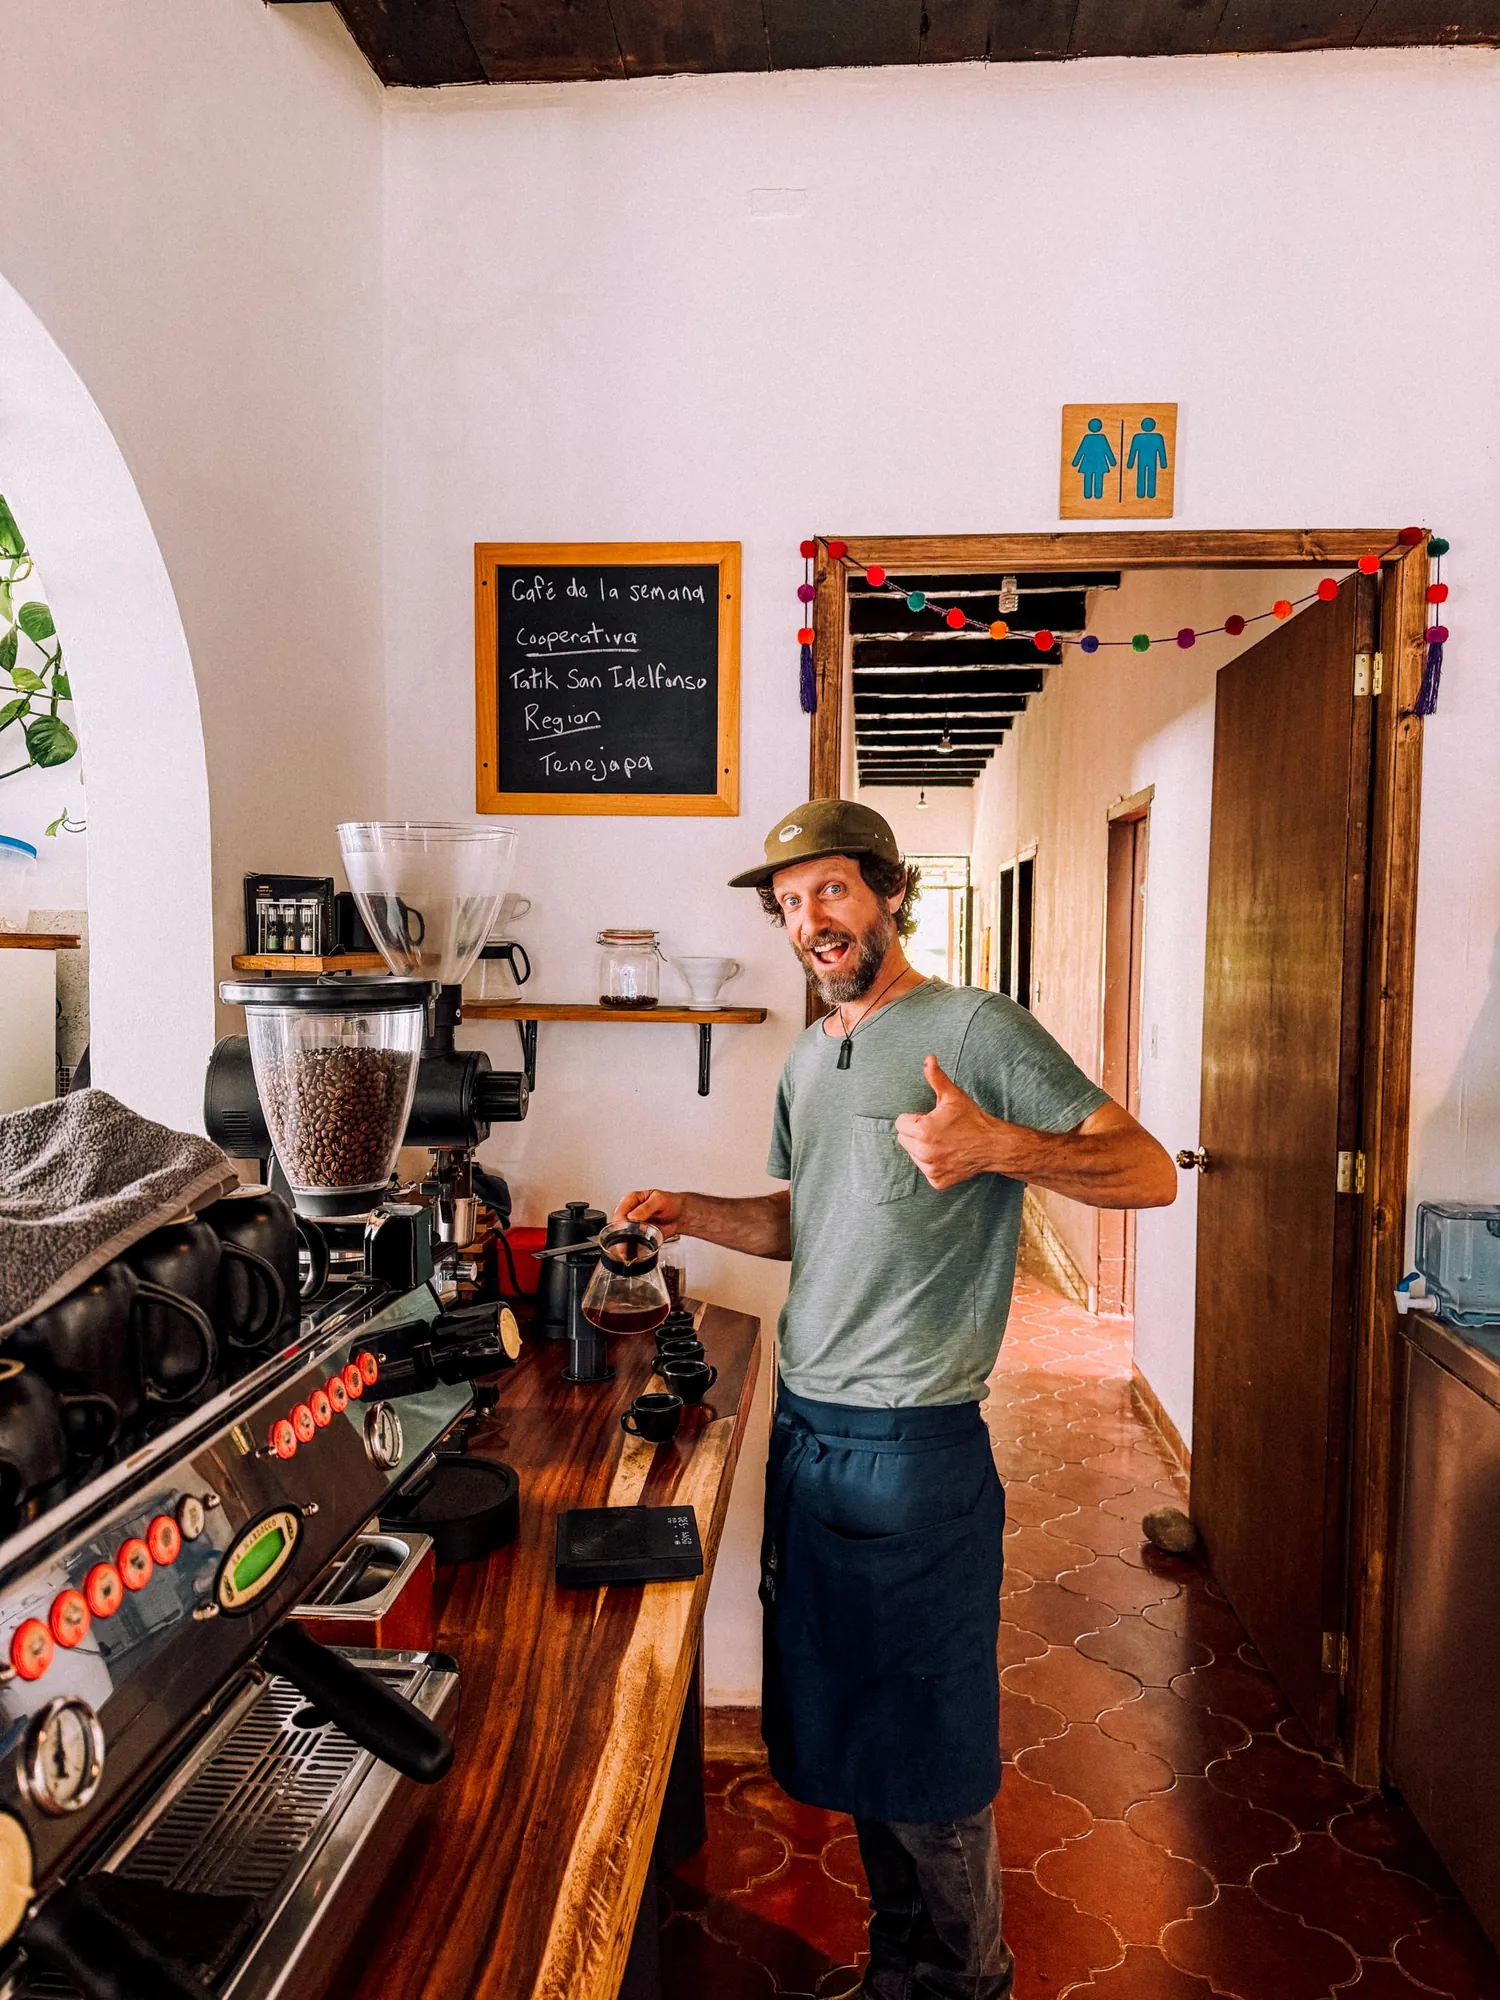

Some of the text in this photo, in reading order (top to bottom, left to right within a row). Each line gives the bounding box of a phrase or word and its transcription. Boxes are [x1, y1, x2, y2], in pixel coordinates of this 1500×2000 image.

[511, 575, 705, 603] Café de la semana
[516, 622, 638, 652] Cooperativa
[509, 662, 707, 690] Tatik San Idelfonso
[524, 703, 601, 734] Region
[539, 746, 653, 781] Tenejapa
